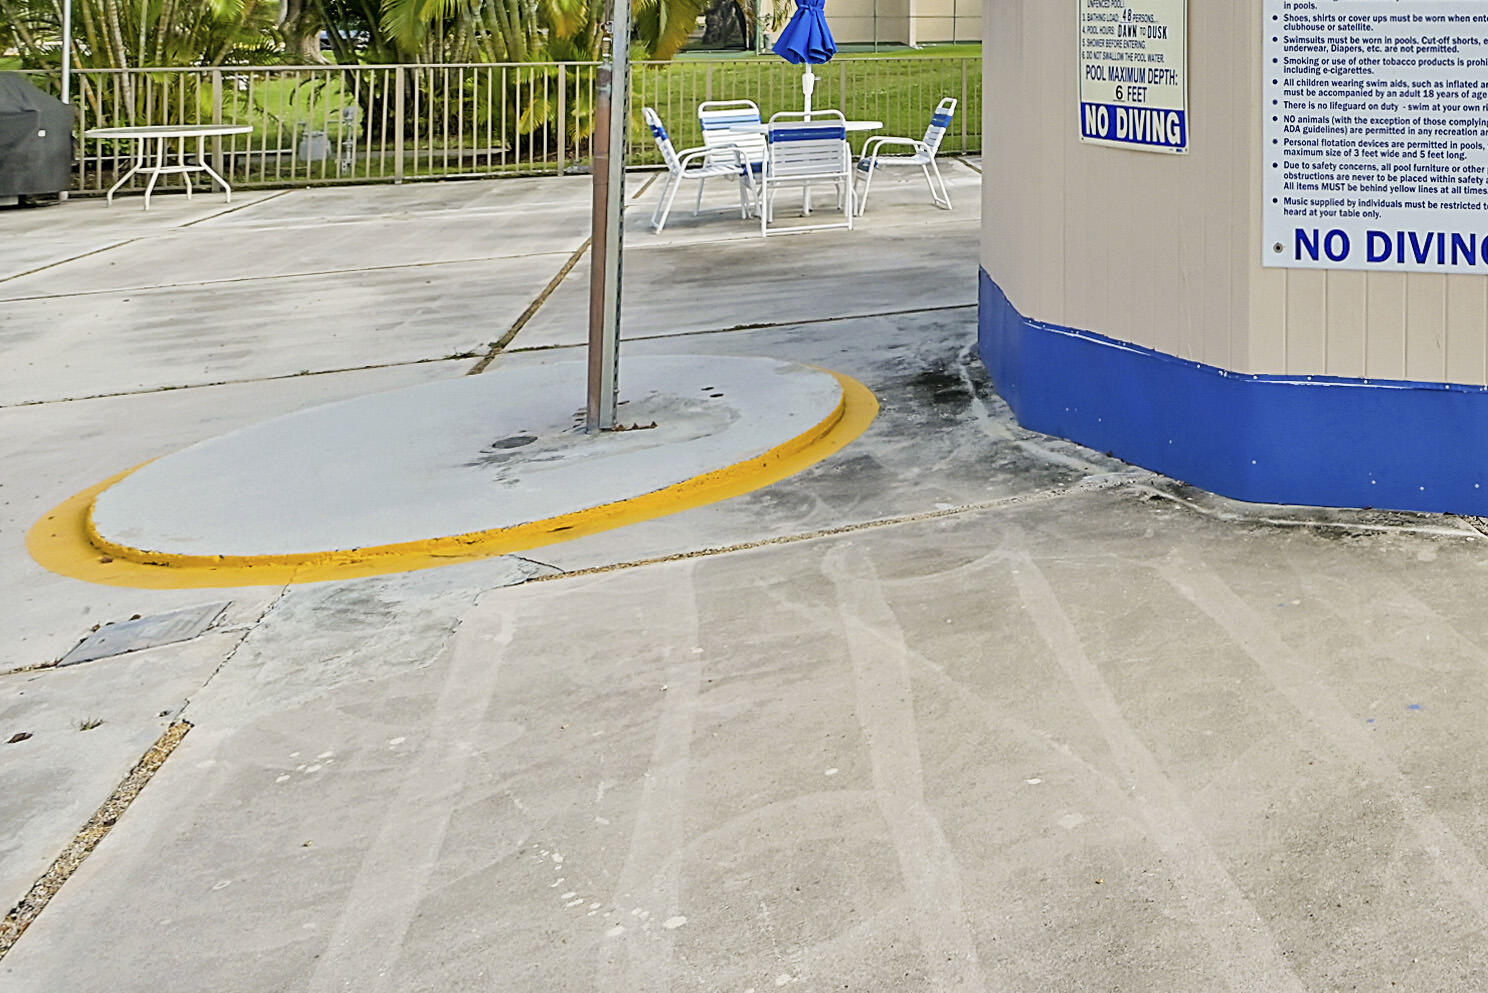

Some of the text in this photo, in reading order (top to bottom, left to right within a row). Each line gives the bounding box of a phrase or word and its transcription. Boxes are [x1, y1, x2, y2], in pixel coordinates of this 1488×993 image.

[1283, 2, 1317, 12] in pools.
[1122, 8, 1132, 22] 48
[1283, 14, 1310, 24] Shoes,
[1312, 14, 1335, 22] shirts
[1372, 16, 1387, 24] ups
[1412, 15, 1423, 23] be
[1447, 15, 1470, 23] when
[1118, 24, 1137, 37] DAWN
[1148, 25, 1168, 39] DUSK
[1283, 23, 1324, 31] clubhouse
[1337, 23, 1372, 31] satellite.
[1283, 36, 1325, 44] Swimsuits
[1327, 36, 1347, 44] must
[1349, 36, 1360, 44] be
[1384, 36, 1392, 44] in
[1394, 36, 1419, 46] pools.
[1451, 37, 1481, 47] shorts,
[1283, 45, 1328, 55] underwear,
[1330, 45, 1364, 55] Diapers,
[1366, 45, 1382, 53] etc.
[1399, 45, 1414, 53] not
[1415, 45, 1459, 55] permitted.
[1086, 65, 1178, 85] POOL MAXIMUM DEPTH:
[1116, 85, 1147, 102] 6 FEET
[1085, 105, 1181, 145] NO DIVING
[1283, 116, 1295, 124] NO
[1297, 116, 1329, 124] animals
[1331, 116, 1352, 126] (with
[1353, 117, 1367, 125] the
[1369, 117, 1410, 127] exception
[1412, 117, 1420, 125] of
[1423, 118, 1446, 126] those
[1283, 125, 1300, 133] ADA
[1302, 125, 1347, 136] guidelines)
[1364, 126, 1405, 137] permitted
[1407, 127, 1415, 135] in
[1417, 129, 1432, 137] any
[1434, 127, 1477, 136] recreation
[1283, 197, 1308, 206] Music
[1309, 198, 1345, 209] supplied
[1346, 199, 1356, 209] by
[1357, 199, 1402, 208] individuals
[1404, 200, 1425, 208] must
[1427, 201, 1438, 209] be
[1440, 201, 1481, 209] restricted
[1283, 208, 1381, 220] heard at your table only.
[1295, 228, 1350, 261] NO
